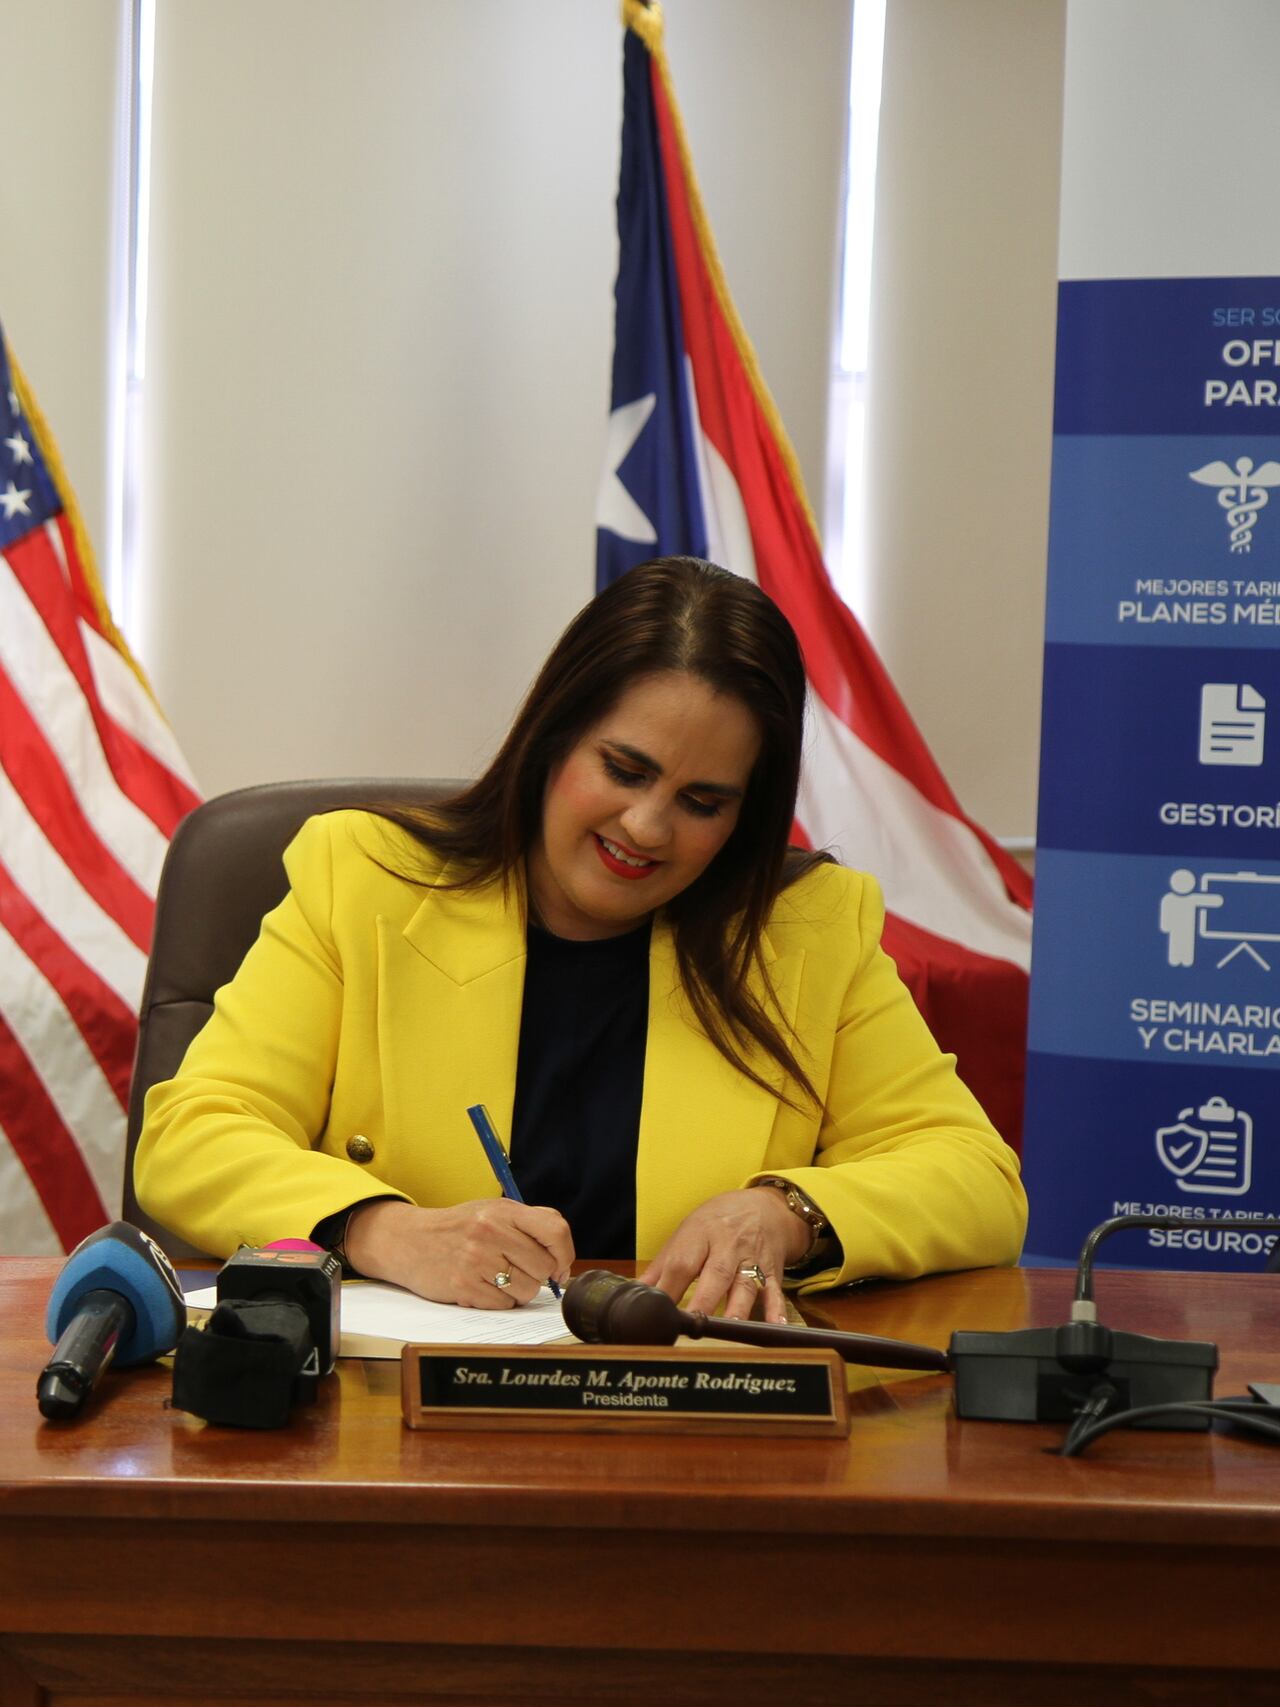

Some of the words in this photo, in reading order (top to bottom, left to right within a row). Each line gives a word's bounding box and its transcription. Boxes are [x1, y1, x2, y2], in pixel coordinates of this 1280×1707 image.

[1213, 307, 1255, 327] SER
[1262, 307, 1280, 327] S
[1204, 379, 1280, 407] PAR
[1136, 579, 1229, 597] MEJORES
[1233, 580, 1280, 597] TARI
[1118, 601, 1227, 625] PLANES
[1233, 599, 1280, 626] MÉ
[1138, 1026, 1158, 1050] Y
[1113, 1201, 1206, 1221] MEJORES
[453, 1367, 493, 1385] Sra.
[500, 1369, 581, 1387] Lourdes
[586, 1370, 613, 1387] M.
[617, 1371, 689, 1391] Aponte
[582, 1392, 669, 1407] Presidenta
